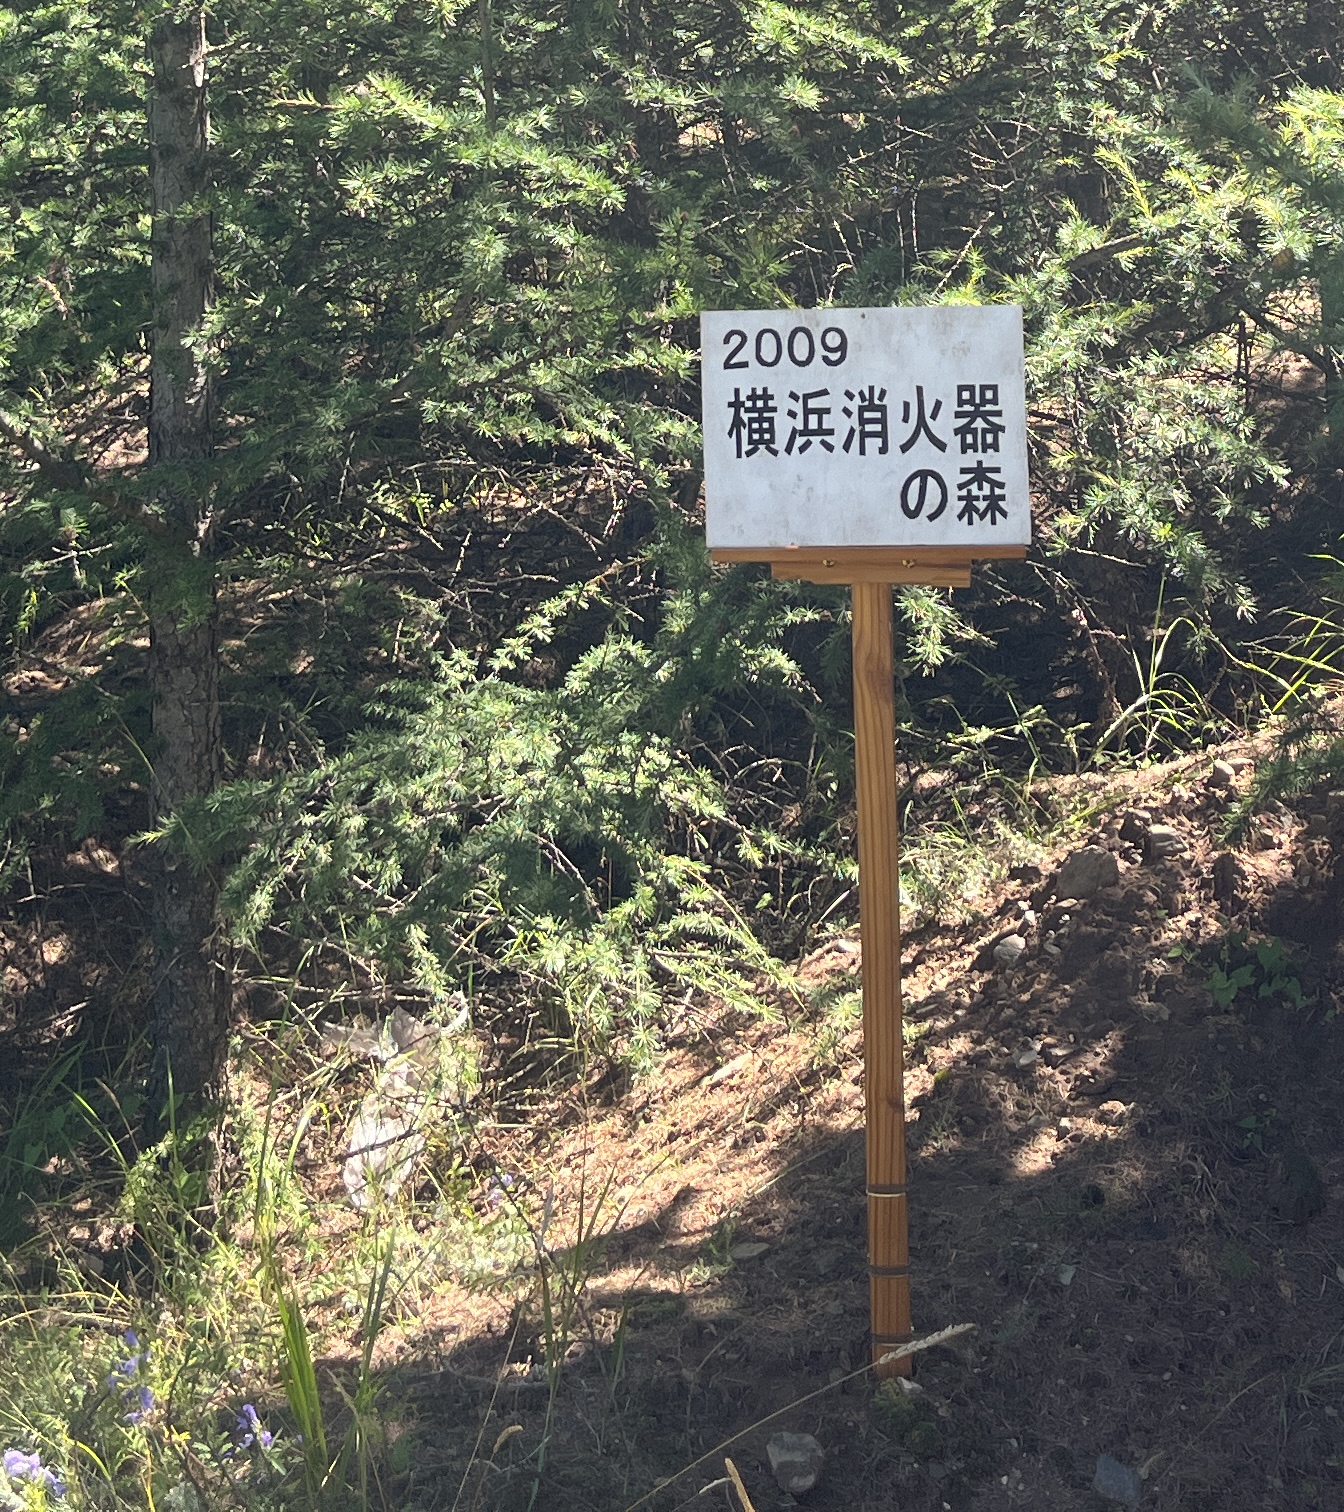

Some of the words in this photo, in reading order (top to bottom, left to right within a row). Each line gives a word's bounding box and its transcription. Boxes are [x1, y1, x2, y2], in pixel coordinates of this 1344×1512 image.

[722, 325, 849, 371] 2009
[726, 383, 1007, 459] 横浜消火器
[899, 459, 1009, 527] の森
